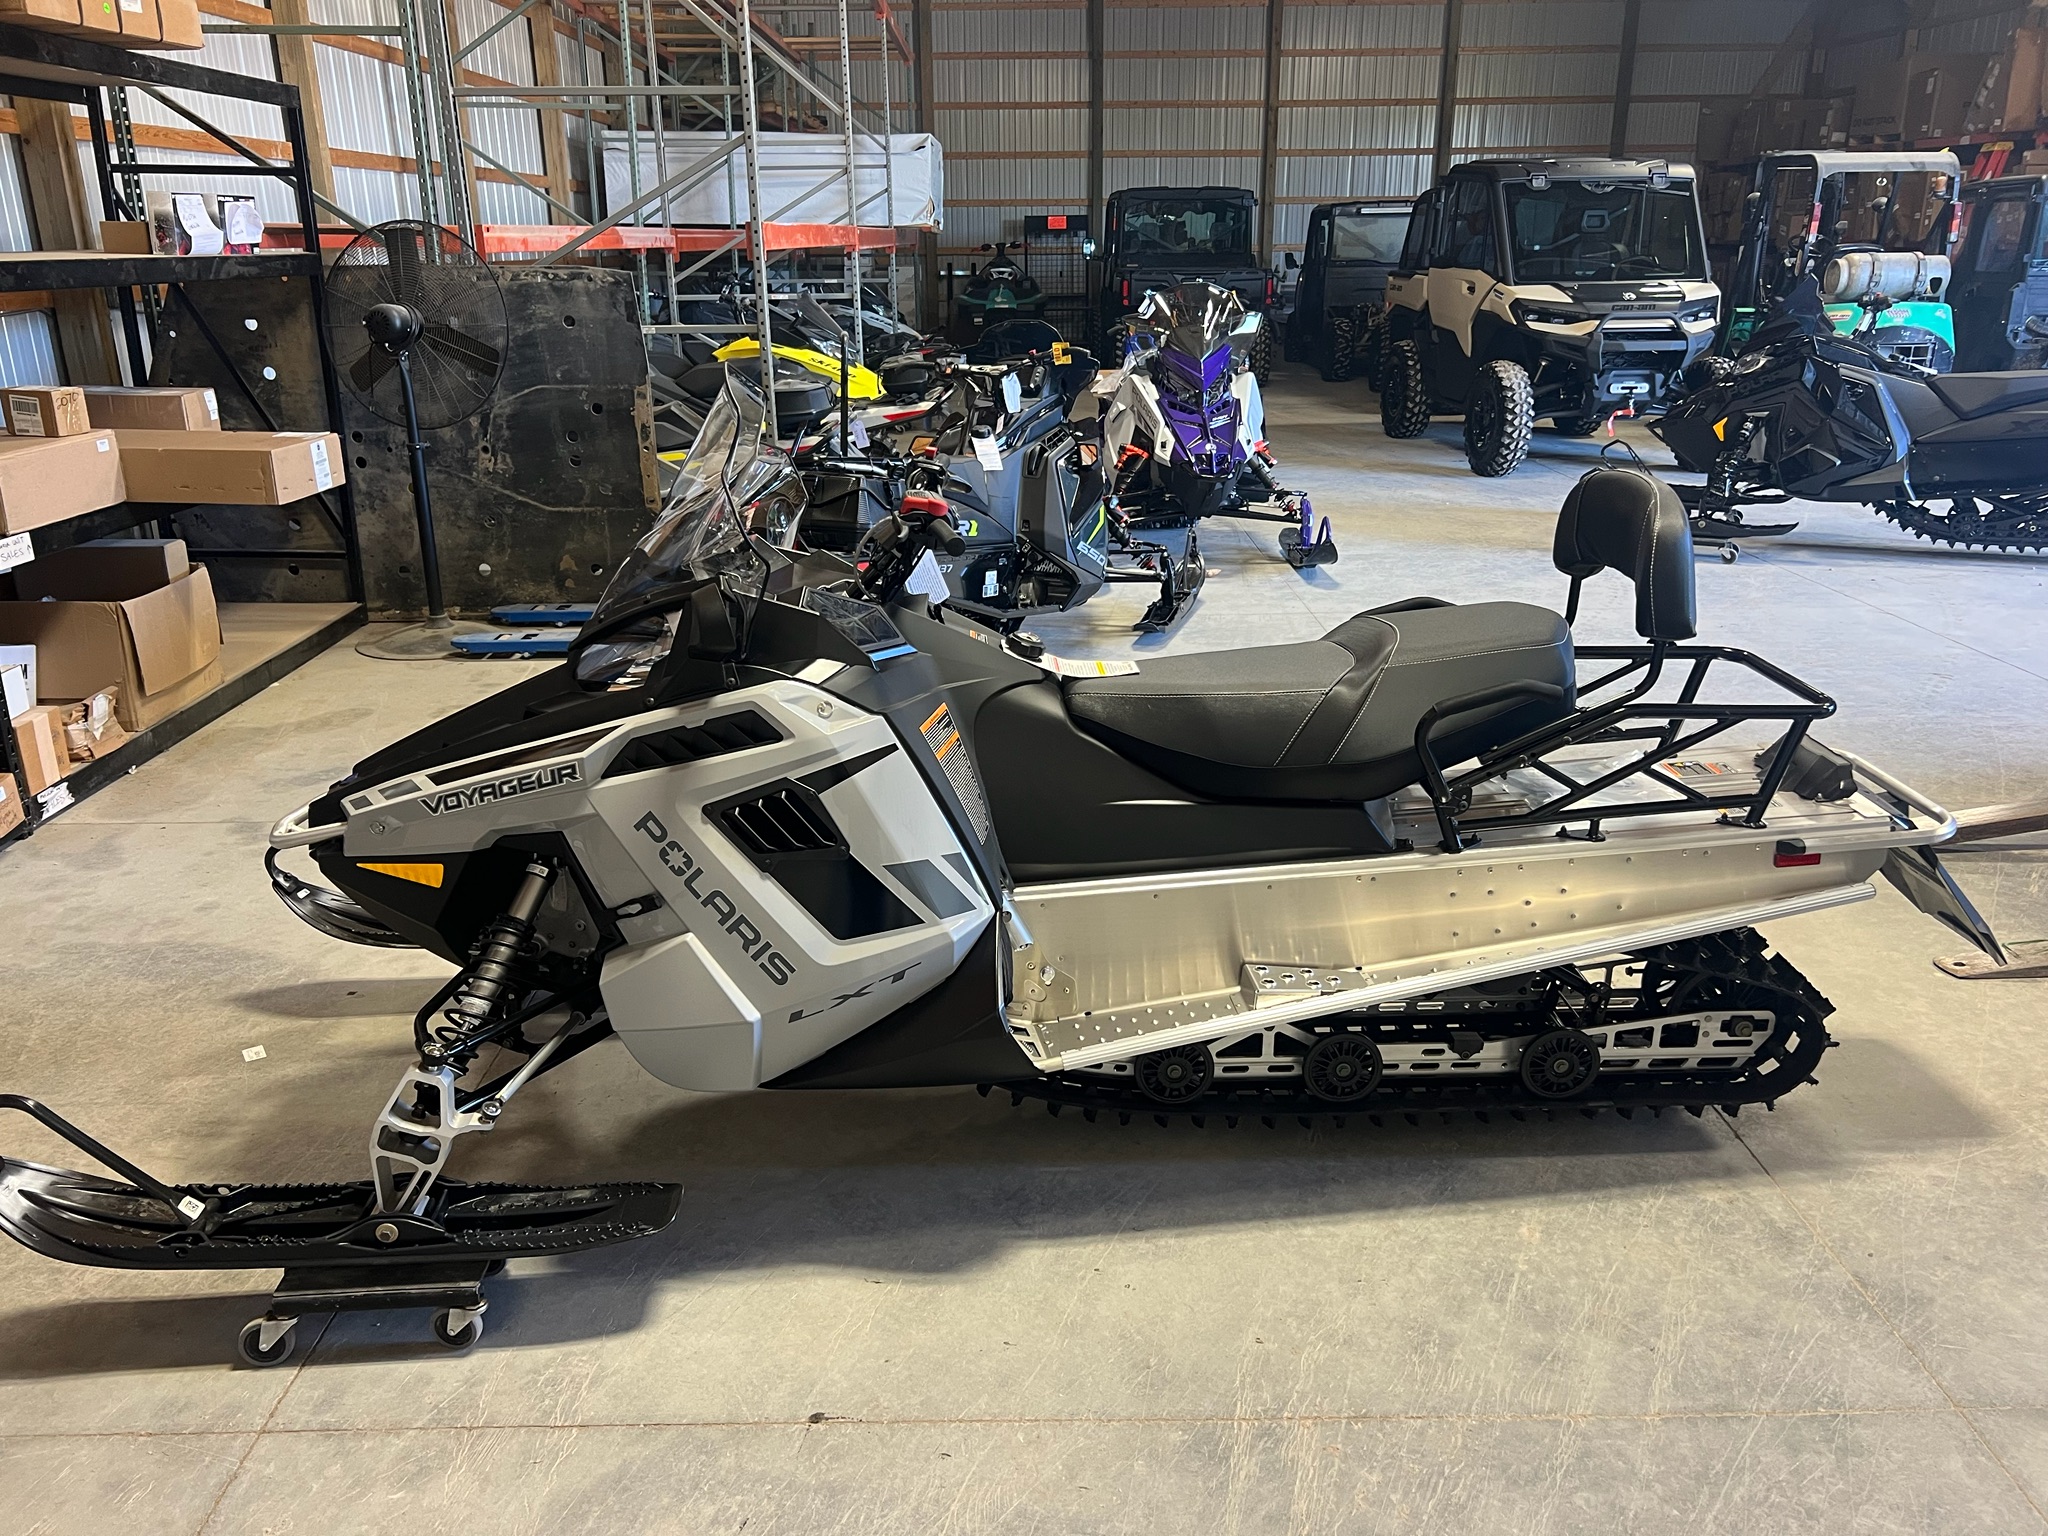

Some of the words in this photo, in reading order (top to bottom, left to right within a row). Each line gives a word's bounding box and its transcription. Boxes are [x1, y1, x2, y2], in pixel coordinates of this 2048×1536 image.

[809, 358, 857, 378] SKI-DO
[1131, 385, 1158, 430] POLARIS
[953, 520, 979, 537] R1
[0, 548, 24, 562] SALES
[1076, 540, 1106, 567] 650
[418, 761, 583, 816] VOYAGEUR
[633, 810, 797, 986] POLARIS
[788, 961, 922, 1023] LXT
